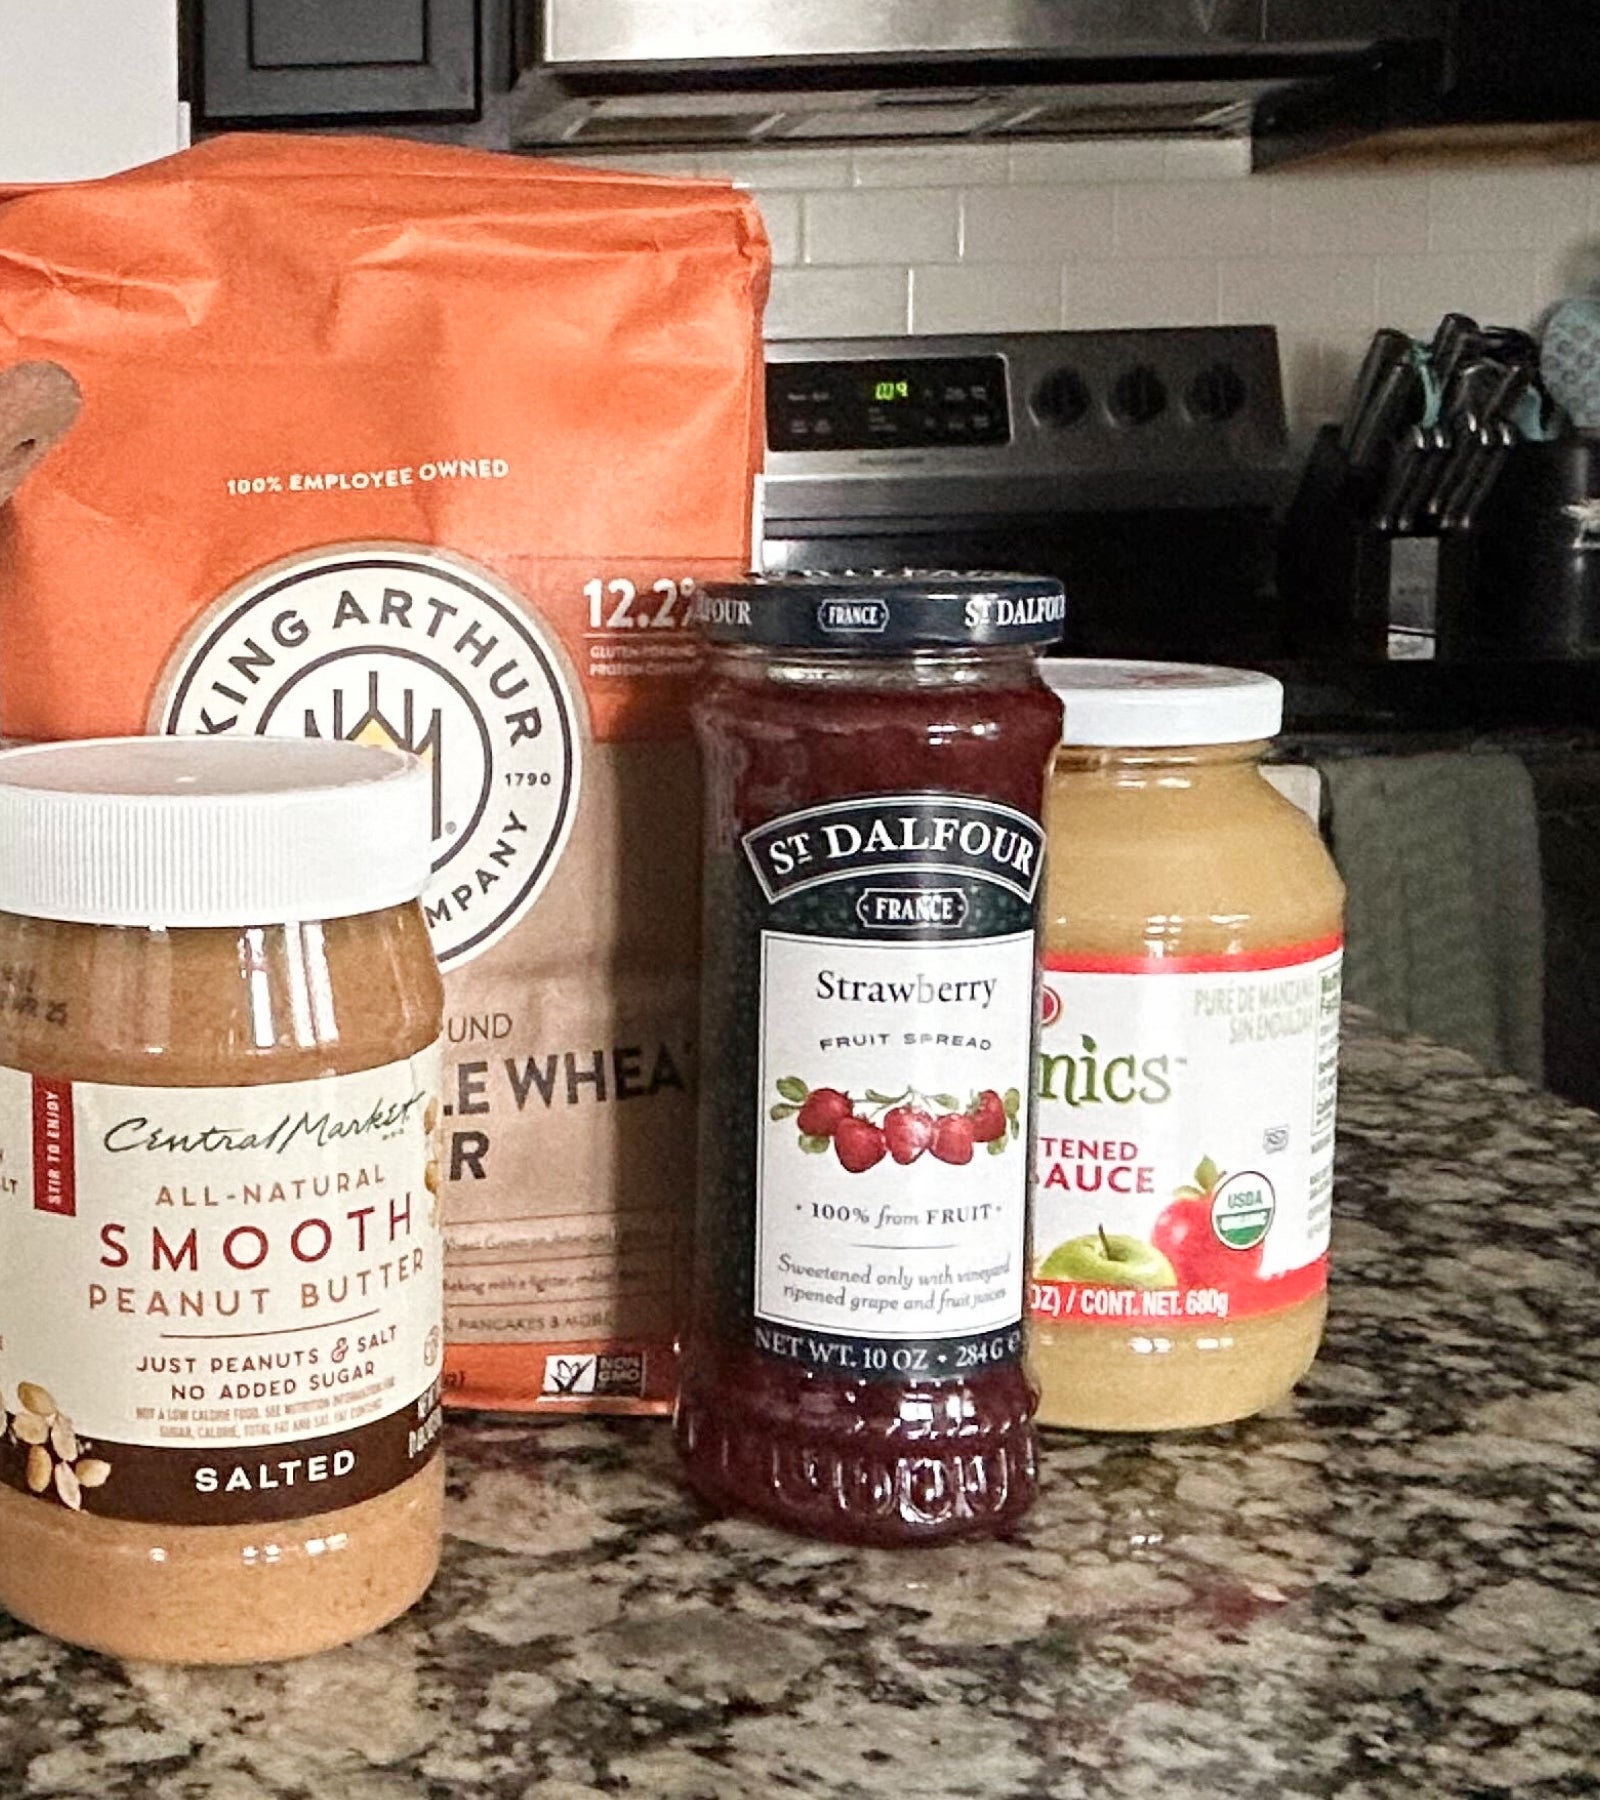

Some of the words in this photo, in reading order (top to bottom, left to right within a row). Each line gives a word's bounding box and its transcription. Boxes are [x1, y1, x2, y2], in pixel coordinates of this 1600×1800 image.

[226, 475, 282, 496] 100%
[289, 467, 412, 492] EMPLOYEE
[418, 458, 509, 482] OWNED
[829, 605, 879, 626] FRANCE
[1000, 594, 1065, 627] DALFOU
[196, 609, 309, 737] KING
[332, 587, 542, 746] ARTHUR
[505, 773, 551, 787] 1790
[824, 816, 1035, 878] DALFOUR
[425, 810, 529, 927] MPANY
[875, 895, 953, 921] FRANCE
[817, 970, 998, 1008] Strawberry
[820, 1033, 891, 1050] FRUIT
[904, 1033, 992, 1050] SPREAD
[504, 1042, 694, 1110] WHEA
[1038, 1034, 1172, 1107] nics
[46, 1091, 61, 1138] ENJOY
[104, 1115, 290, 1154] Central
[277, 1089, 426, 1154] Market
[46, 1143, 61, 1163] TO
[1040, 1137, 1138, 1161] TENED
[47, 1168, 63, 1205] STIR
[155, 1164, 386, 1208] ALL-NATURAL
[1036, 1162, 1155, 1194] AUCE
[811, 1203, 870, 1224] 100%
[875, 1205, 919, 1229] from
[927, 1203, 992, 1225] FRUIT
[1228, 1190, 1263, 1208] USDA
[100, 1191, 412, 1272] SMOOTH
[89, 1283, 272, 1316] PEANUT
[301, 1248, 424, 1308] BUTTER
[778, 1253, 871, 1284] Sweetened
[877, 1266, 913, 1290] only
[919, 1264, 953, 1285] with
[784, 1284, 845, 1306] ripened
[850, 1295, 898, 1314] grape
[904, 1290, 935, 1310] and
[936, 1290, 971, 1314] fruit
[1080, 1287, 1140, 1316] CONT.
[1142, 1290, 1184, 1317] NET.
[1185, 1290, 1229, 1318] 680g
[136, 1356, 197, 1374] JUST
[211, 1348, 320, 1373] PEANUTS
[331, 1337, 349, 1364] &
[357, 1325, 397, 1353] SALT
[600, 1357, 640, 1370] NON
[754, 1327, 801, 1358] NET
[808, 1337, 857, 1367] WT.
[863, 1349, 885, 1369] 10
[892, 1349, 929, 1371] OZ
[171, 1384, 205, 1401] NO
[220, 1378, 297, 1400] ADDED
[309, 1361, 376, 1392] SUGAR
[599, 1369, 640, 1382] GMO
[158, 1408, 166, 1421] A
[195, 1450, 356, 1492] SALTED
